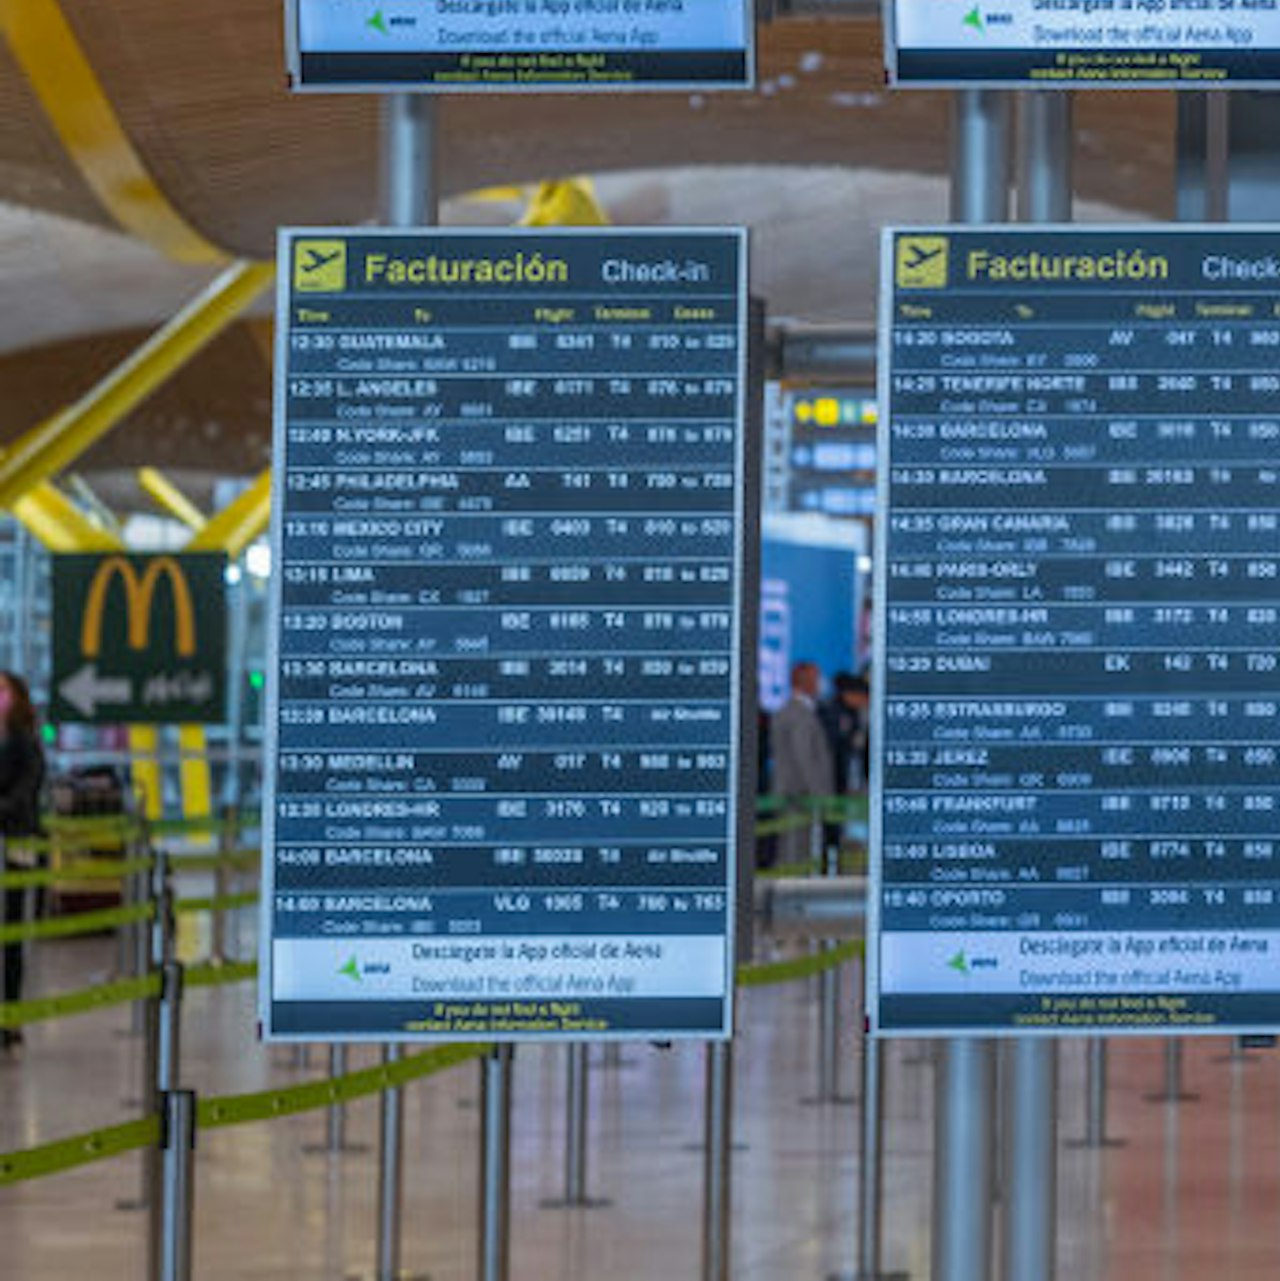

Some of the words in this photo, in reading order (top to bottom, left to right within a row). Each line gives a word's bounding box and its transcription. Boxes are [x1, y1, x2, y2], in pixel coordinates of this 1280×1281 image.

[365, 253, 568, 283] Facturación
[602, 260, 709, 283] Check-in
[967, 250, 1168, 280] Facturación
